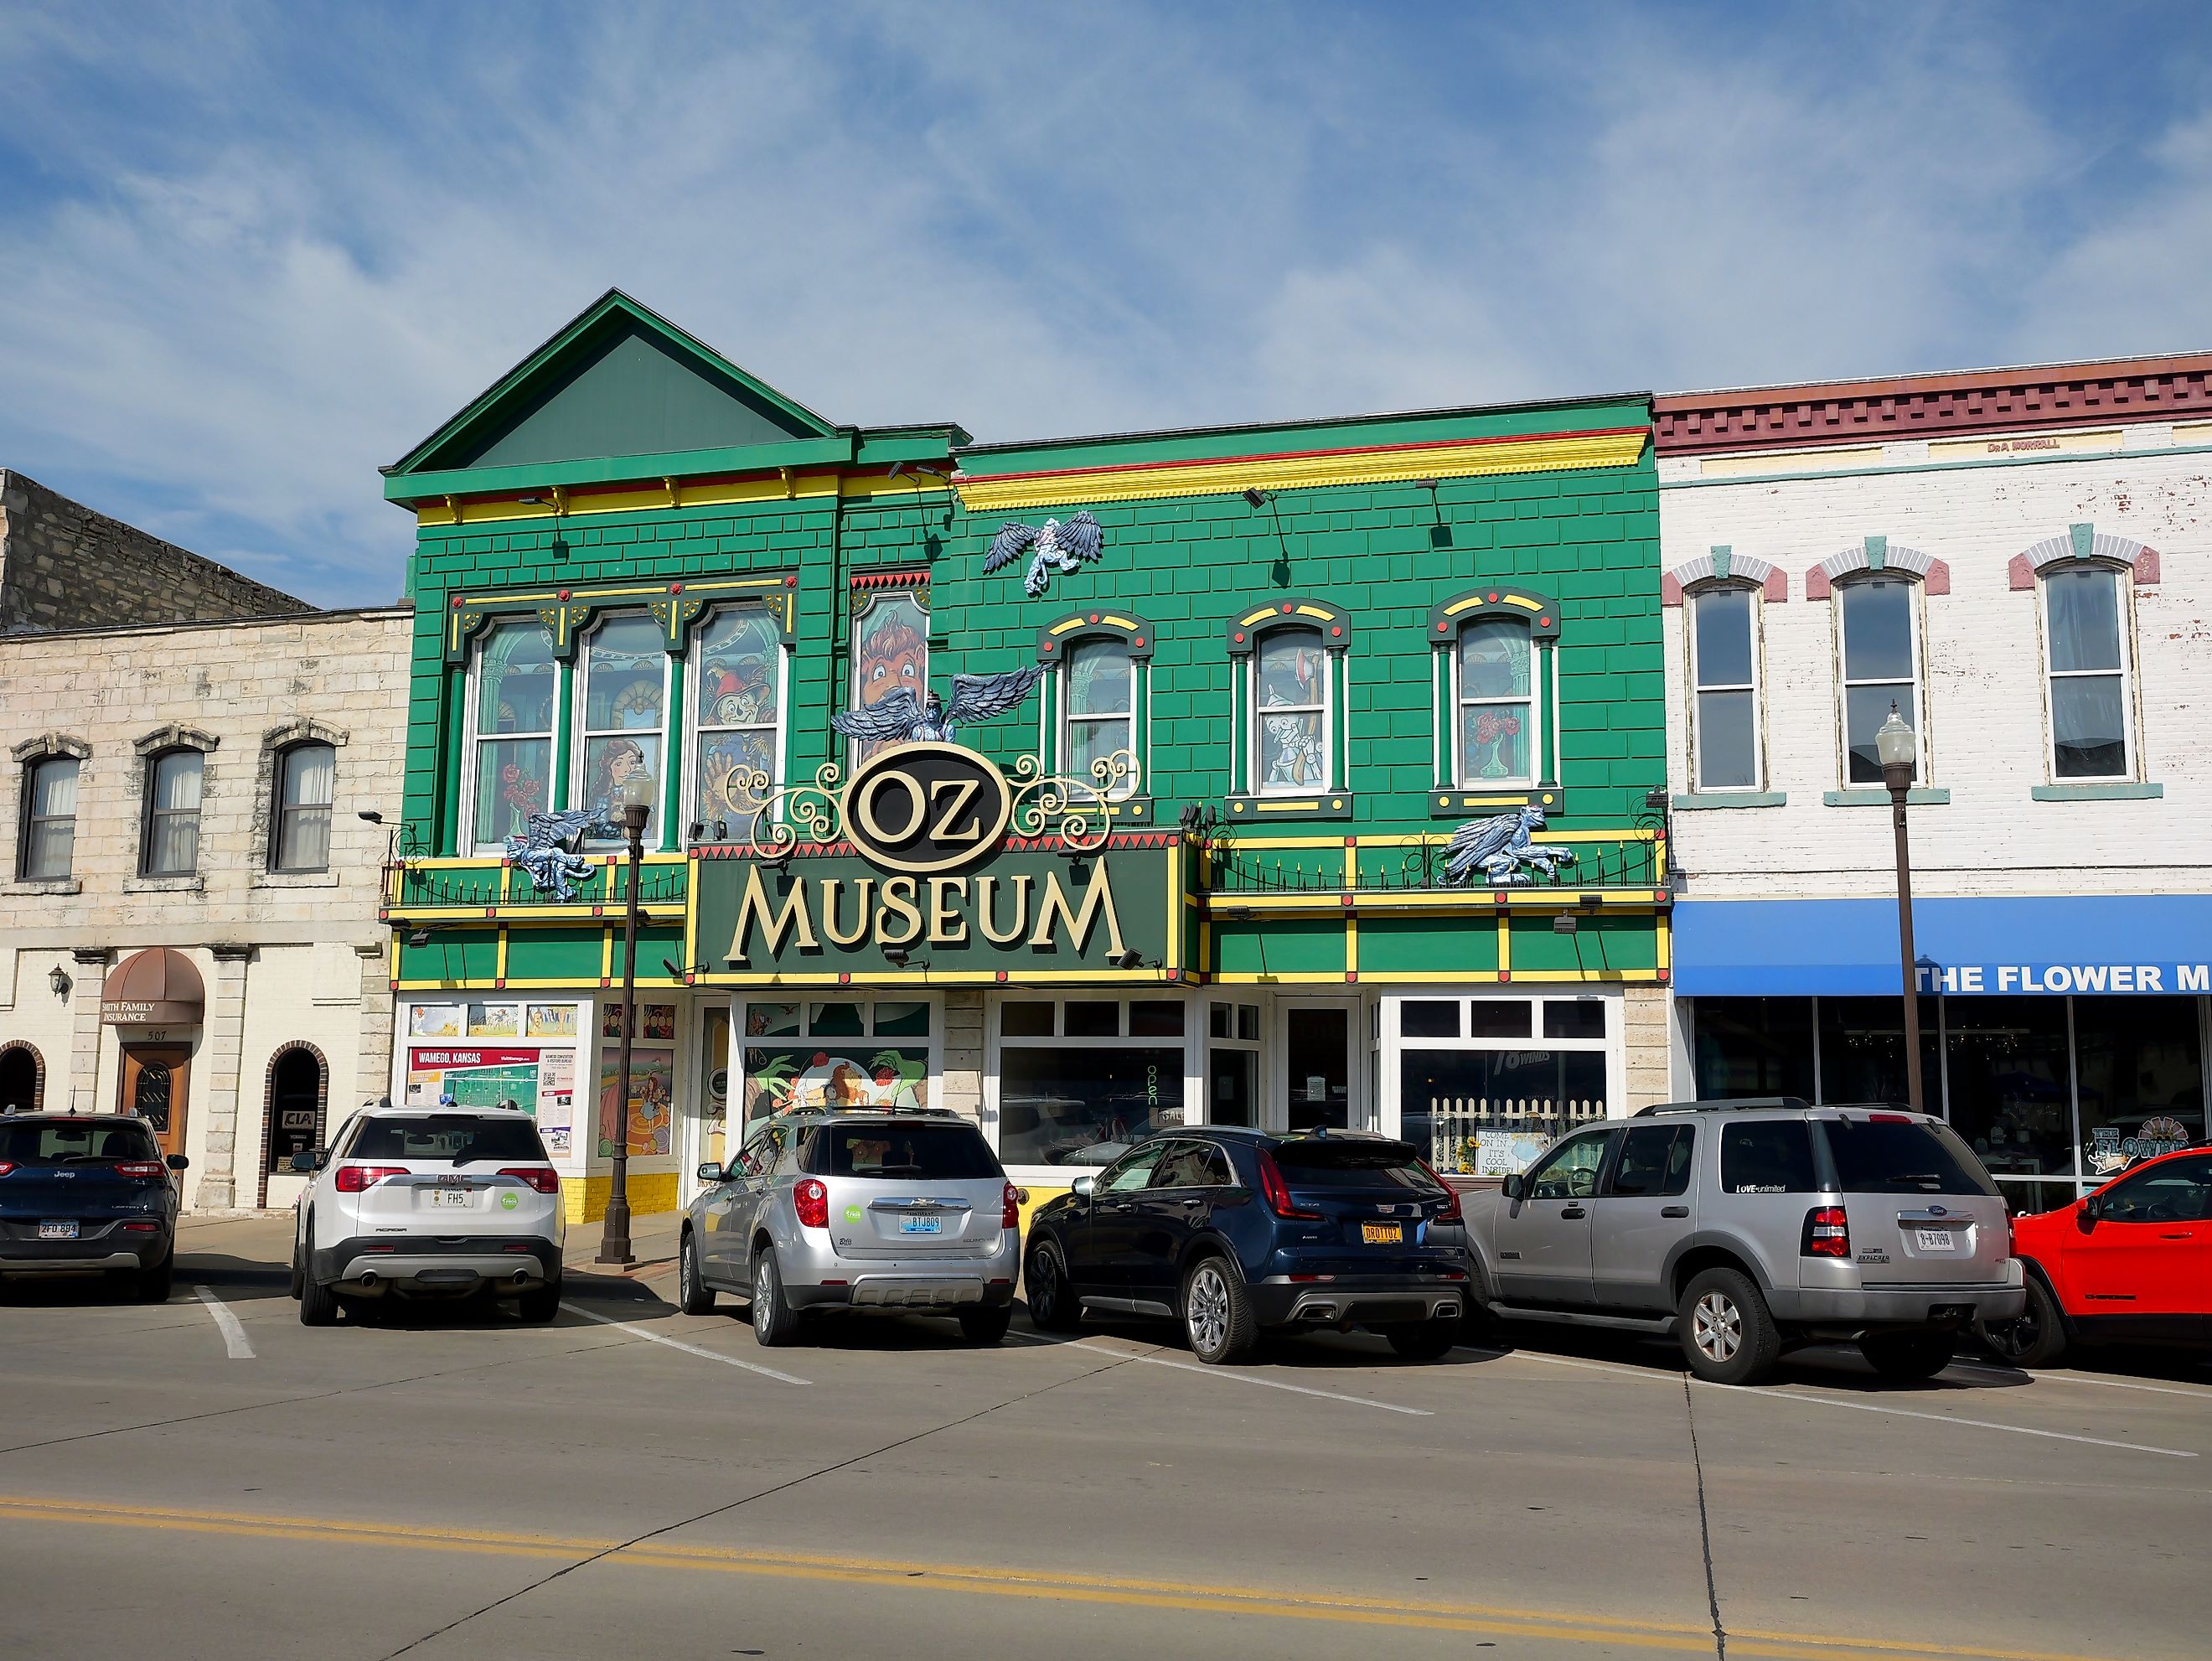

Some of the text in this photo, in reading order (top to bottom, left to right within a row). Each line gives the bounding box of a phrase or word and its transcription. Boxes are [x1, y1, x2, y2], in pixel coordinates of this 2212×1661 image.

[858, 770, 979, 843] OZ
[722, 855, 1128, 962] MUSEUM
[1913, 966, 1984, 992] THE
[1998, 965, 2164, 992] FLOWER
[121, 1001, 155, 1012] FAMILY
[103, 1012, 146, 1022] INSURANCE
[147, 1031, 167, 1041] 507
[419, 1052, 481, 1064] WAMEGO, KANSAS
[1147, 1065, 1158, 1105] open
[285, 1113, 313, 1126] CIA
[1480, 1139, 1493, 1147] ON
[1489, 1149, 1505, 1157] IT'S
[54, 1171, 75, 1179] Jeep
[1481, 1166, 1514, 1174] INSIDE!
[437, 1174, 473, 1183] GMC
[447, 1193, 464, 1204] FH5
[1931, 1206, 1945, 1214] Ford
